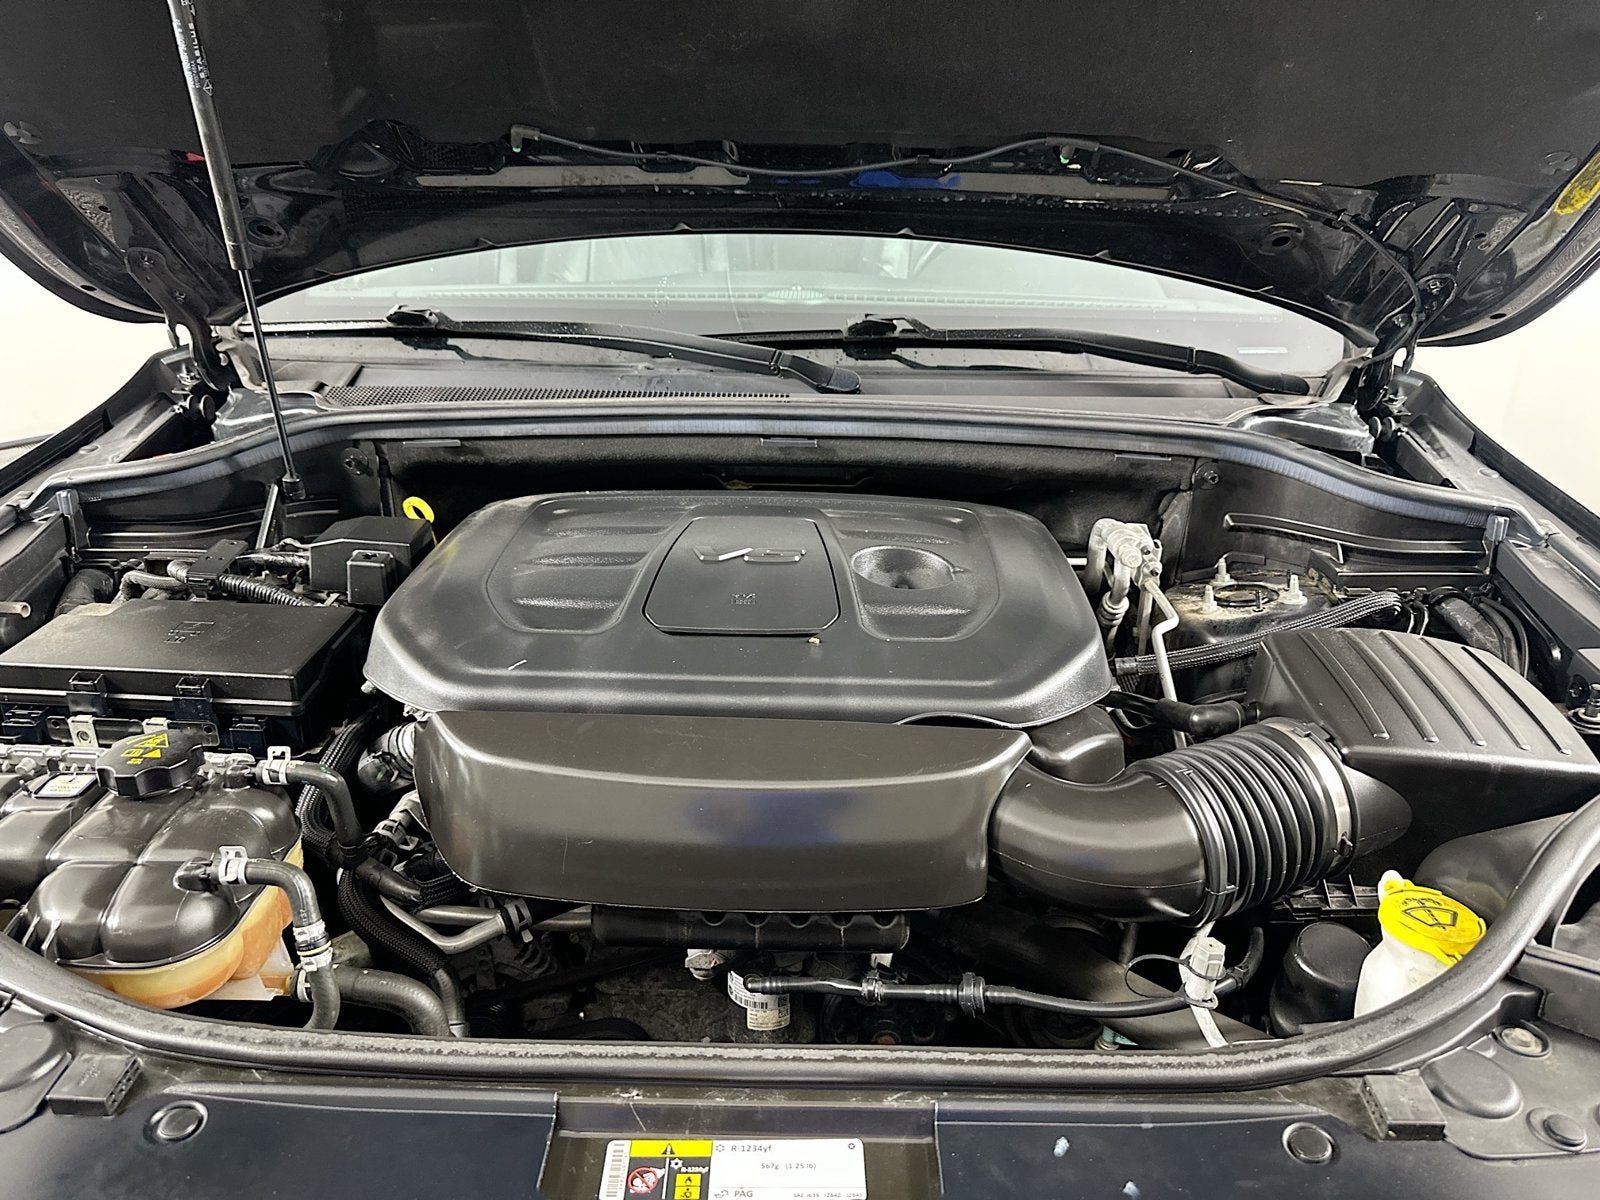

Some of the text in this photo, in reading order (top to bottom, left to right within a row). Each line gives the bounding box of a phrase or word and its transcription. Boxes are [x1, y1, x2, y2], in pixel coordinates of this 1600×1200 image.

[187, 22, 206, 79] STABILUS
[730, 1143, 773, 1154] R-1234yf
[760, 1162, 780, 1171] 567g
[784, 1162, 805, 1171] (125
[733, 1189, 754, 1198] PAG
